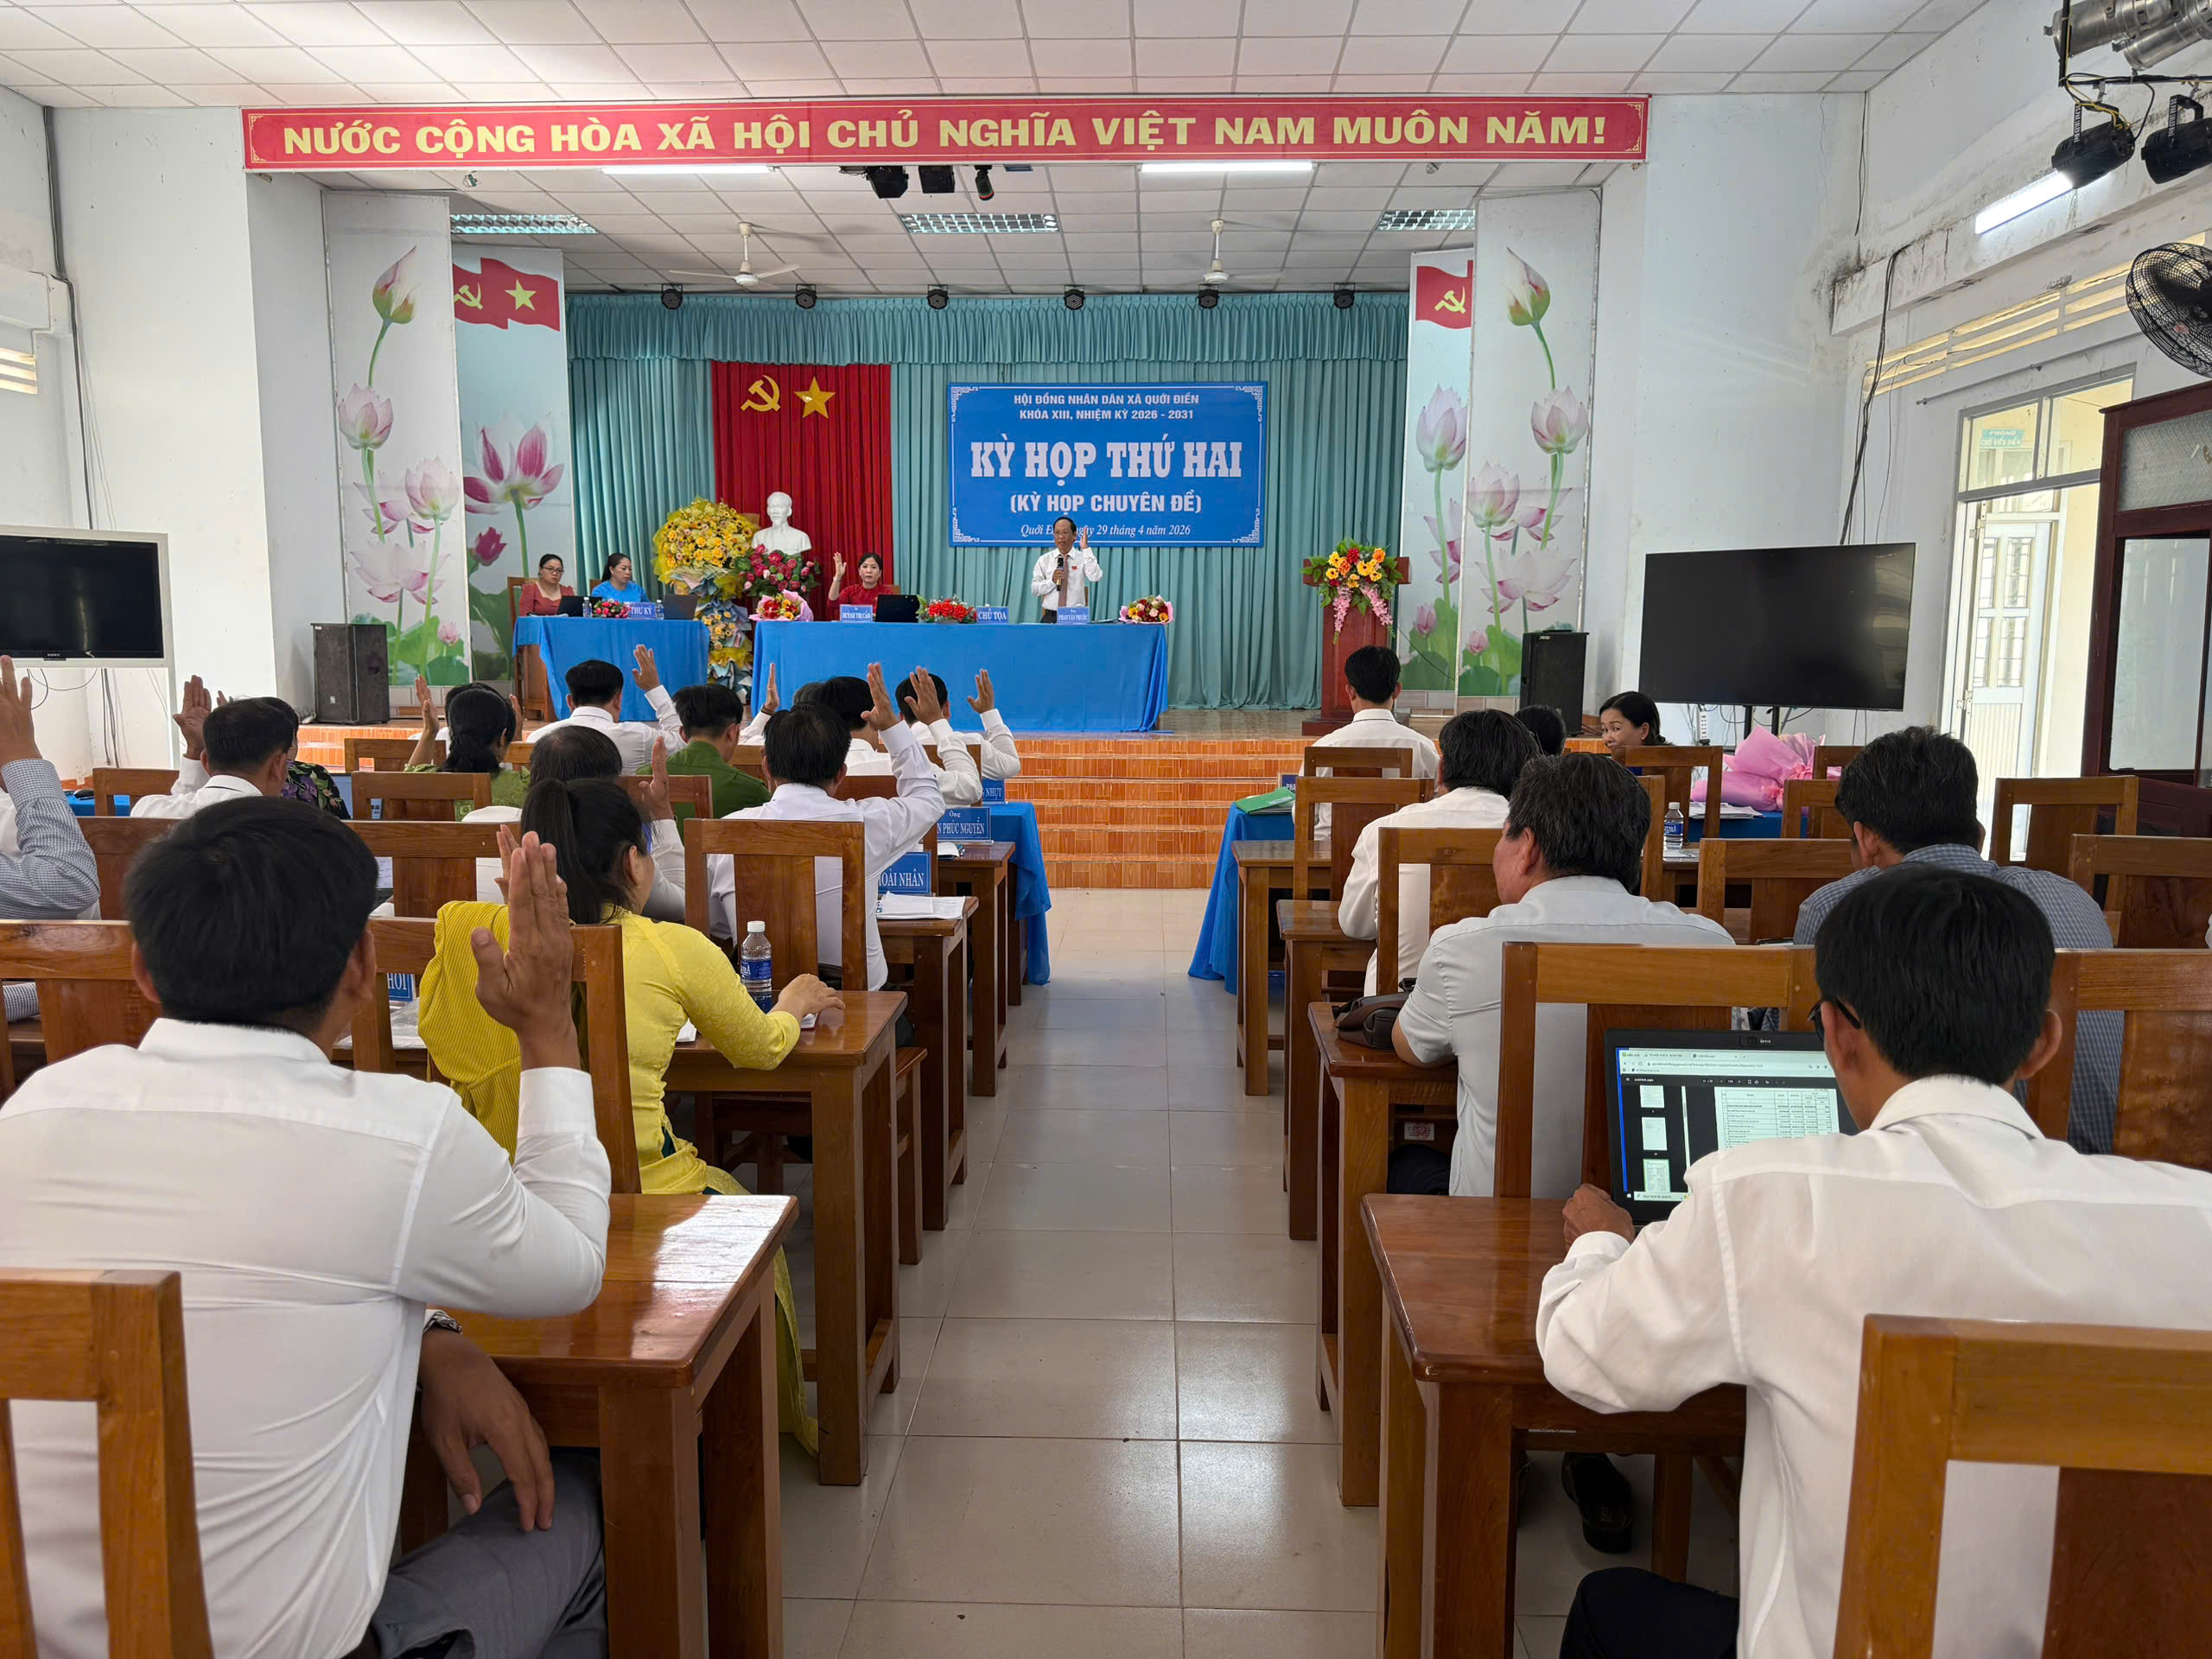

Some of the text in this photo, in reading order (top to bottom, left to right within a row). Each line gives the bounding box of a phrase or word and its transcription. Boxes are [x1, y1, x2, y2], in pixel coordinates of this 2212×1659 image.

[283, 109, 1605, 158] NƯỚC CỘNG HÒA XÃ HỘI CHỦ NGHĨA VIỆT NAM MUÔN NĂM!
[1014, 393, 1033, 406] HỘI
[1068, 393, 1099, 404] NHÂN
[1102, 393, 1124, 404] DÂN
[1127, 393, 1142, 404] XÃ
[1020, 408, 1049, 419] KHÓA
[1052, 410, 1073, 420] XIII,
[1076, 408, 1112, 422] NHIỆM
[1131, 410, 1158, 419] 2026
[1168, 410, 1193, 419] 2031
[970, 433, 1243, 486] KỲ HỌP THỨ HAI
[1010, 489, 1202, 515] (KỲ HỌP CHUYÊN ĐỀ)
[1096, 524, 1109, 535] 29
[1109, 524, 1136, 537] tháng
[1138, 525, 1145, 535] 4
[1146, 524, 1166, 535] năm
[1168, 524, 1192, 535] 2026
[943, 819, 960, 835] PHÚC
[899, 868, 925, 887] NHÂN
